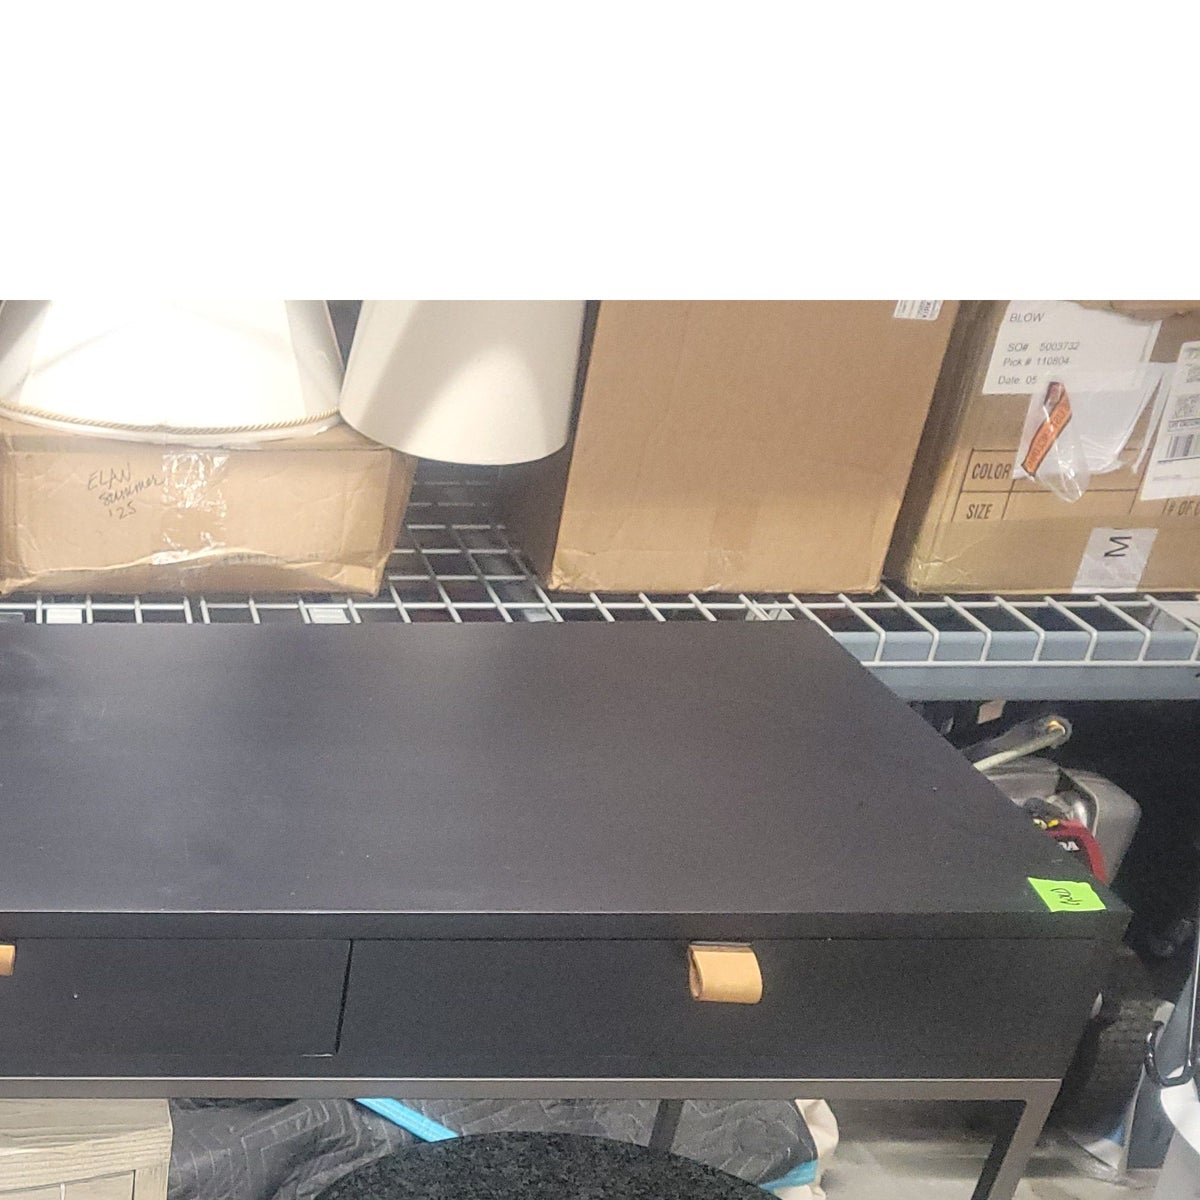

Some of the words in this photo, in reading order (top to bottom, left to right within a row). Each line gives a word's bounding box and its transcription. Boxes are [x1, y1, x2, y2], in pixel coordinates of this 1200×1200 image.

[1009, 312, 1044, 323] BLOW
[971, 463, 1012, 480] COLOR
[966, 503, 993, 520] SIZE
